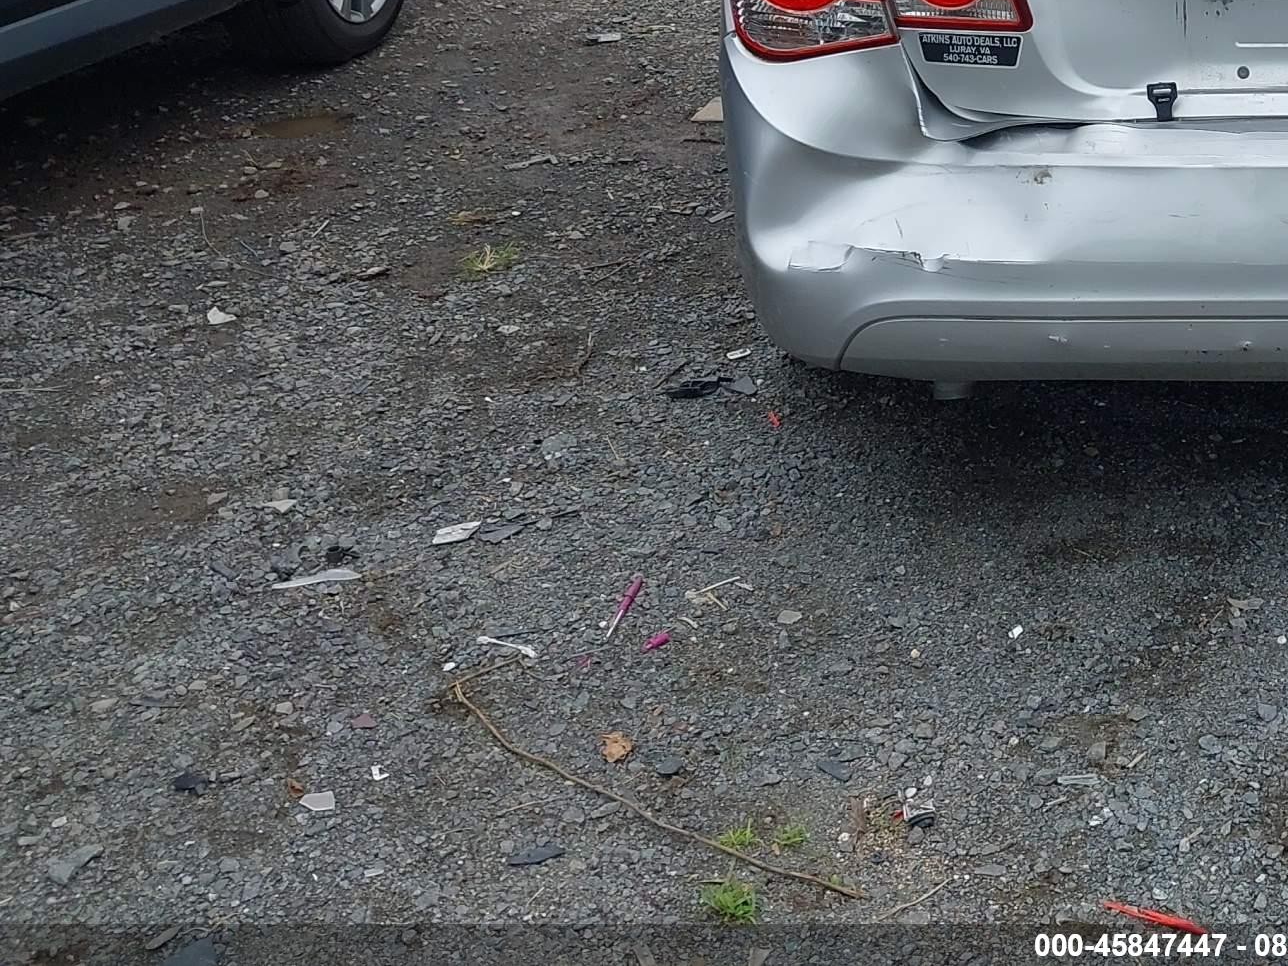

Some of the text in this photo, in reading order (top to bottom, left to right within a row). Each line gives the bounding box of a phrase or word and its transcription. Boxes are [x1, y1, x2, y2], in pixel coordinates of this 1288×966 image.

[922, 34, 1018, 48] ATKINS AUTO DEALS, LLC
[949, 45, 991, 55] LURAY, VA
[943, 53, 999, 65] 540-743-CARS
